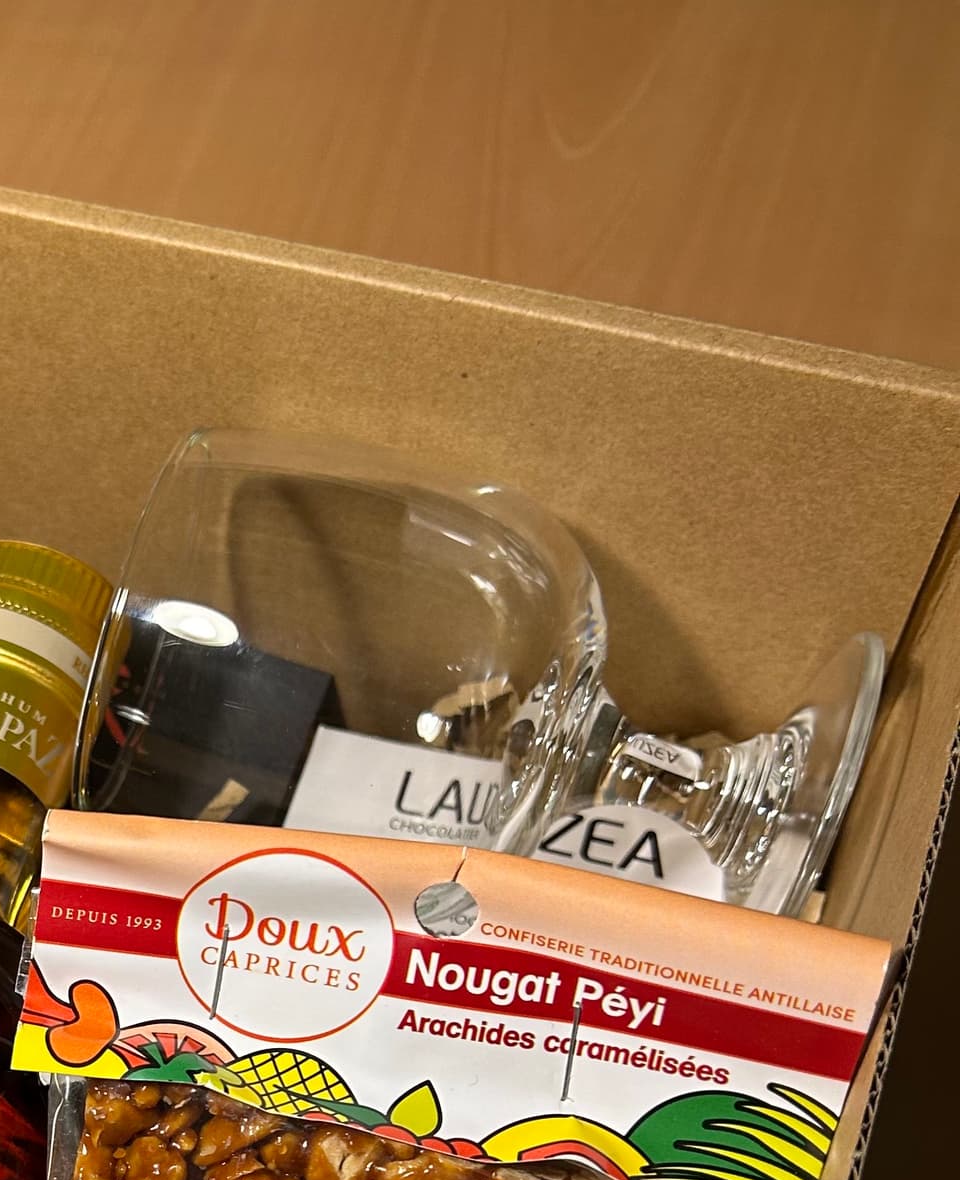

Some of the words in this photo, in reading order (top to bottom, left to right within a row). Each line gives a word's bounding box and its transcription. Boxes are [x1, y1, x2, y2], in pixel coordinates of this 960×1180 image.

[51, 905, 119, 926] DEPUIS
[126, 915, 163, 932] 1993
[205, 892, 366, 963] Doux
[201, 945, 362, 992] CAPRICES
[405, 948, 563, 1007] Nougat
[573, 976, 668, 1030] Péyi
[481, 921, 585, 958] CONFISERIE
[590, 948, 744, 997] TRADITIONNELLE
[748, 986, 856, 1023] ANTILLAISE
[397, 1008, 536, 1051] Arachides
[543, 1033, 731, 1085] caramélisées
